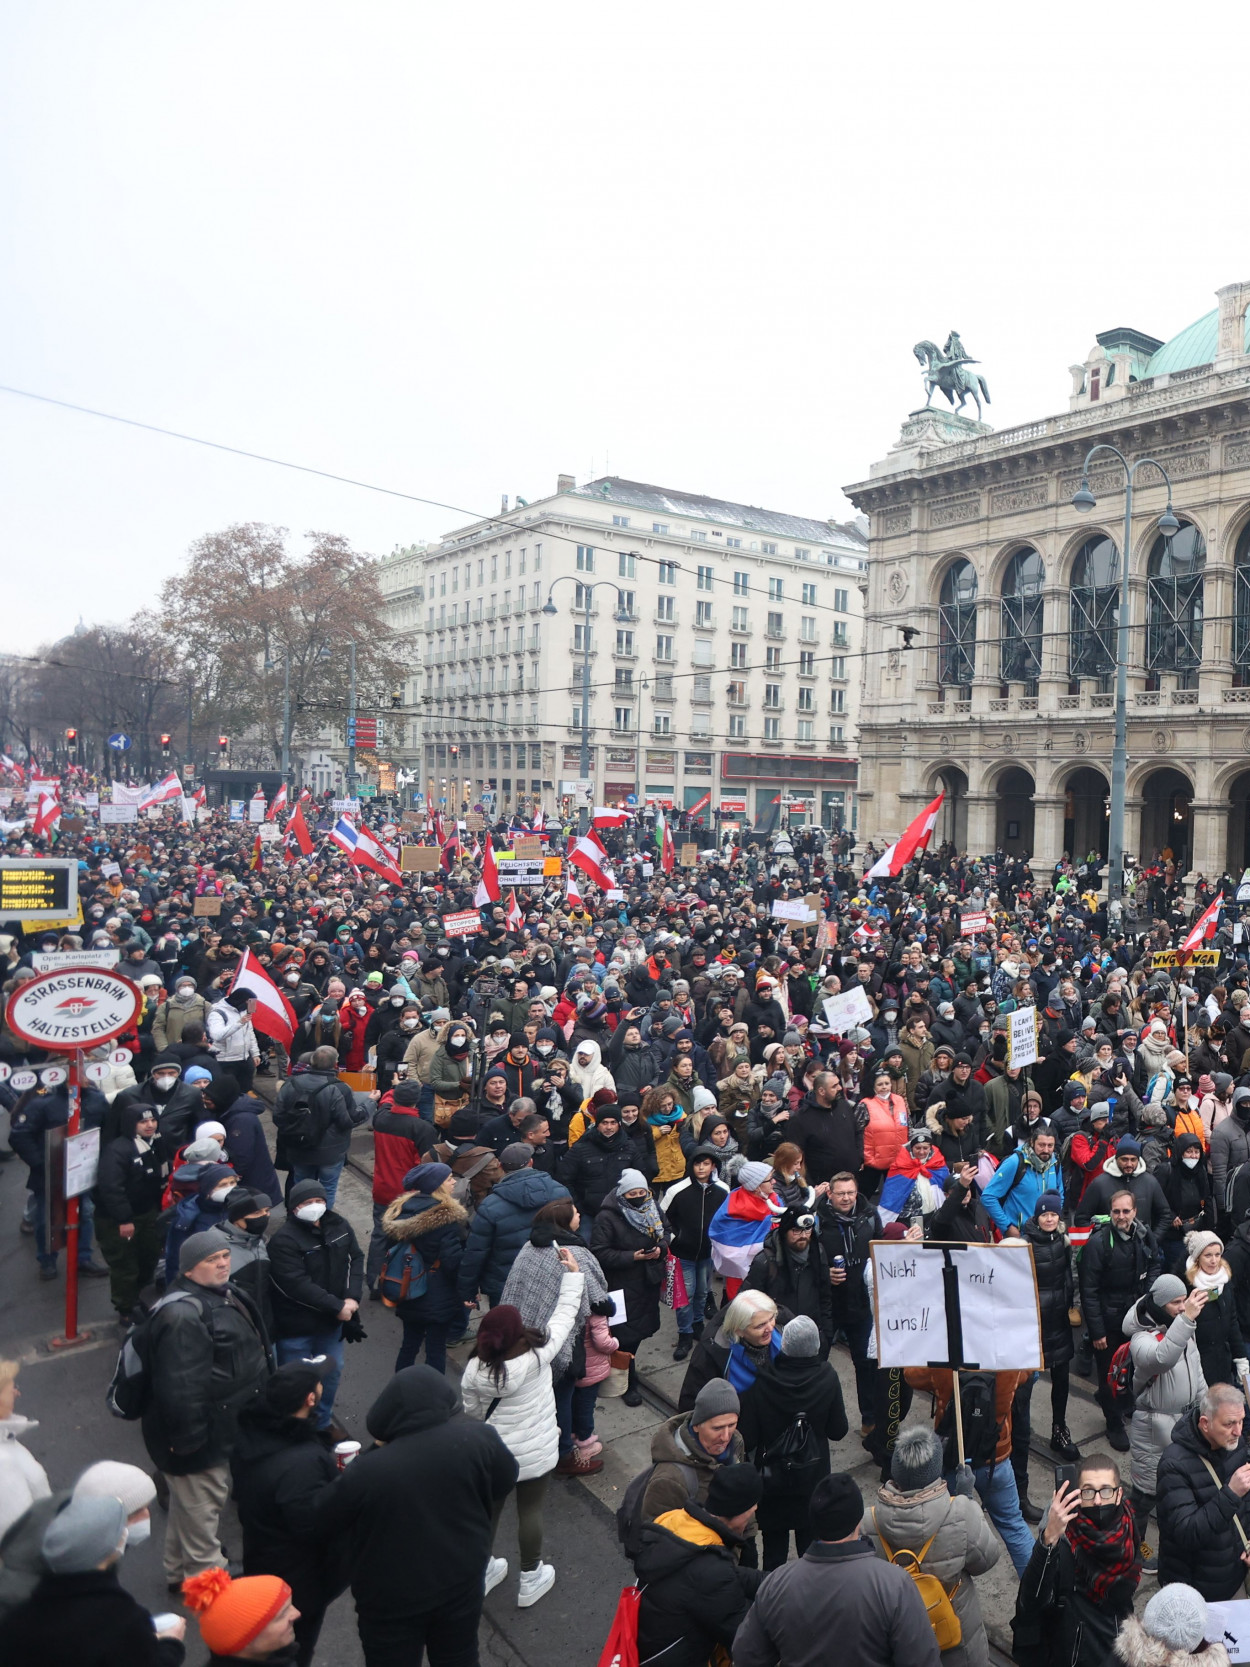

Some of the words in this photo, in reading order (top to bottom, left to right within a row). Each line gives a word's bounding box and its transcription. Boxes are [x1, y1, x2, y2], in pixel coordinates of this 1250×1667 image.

[449, 926, 479, 935] SOFORT
[1154, 956, 1176, 966] WWG
[1192, 954, 1214, 965] WGA
[24, 977, 128, 1006] STRASSENBAHN
[27, 1012, 122, 1037] HALTESTELLE
[1014, 1041, 1034, 1052] PROTEST
[116, 1052, 126, 1062] D
[0, 1067, 7, 1077] 1
[49, 1071, 59, 1081] 2
[96, 1067, 101, 1076] 1
[13, 1076, 34, 1085] U2Z
[880, 1259, 916, 1280] Nicht
[970, 1268, 994, 1284] mit
